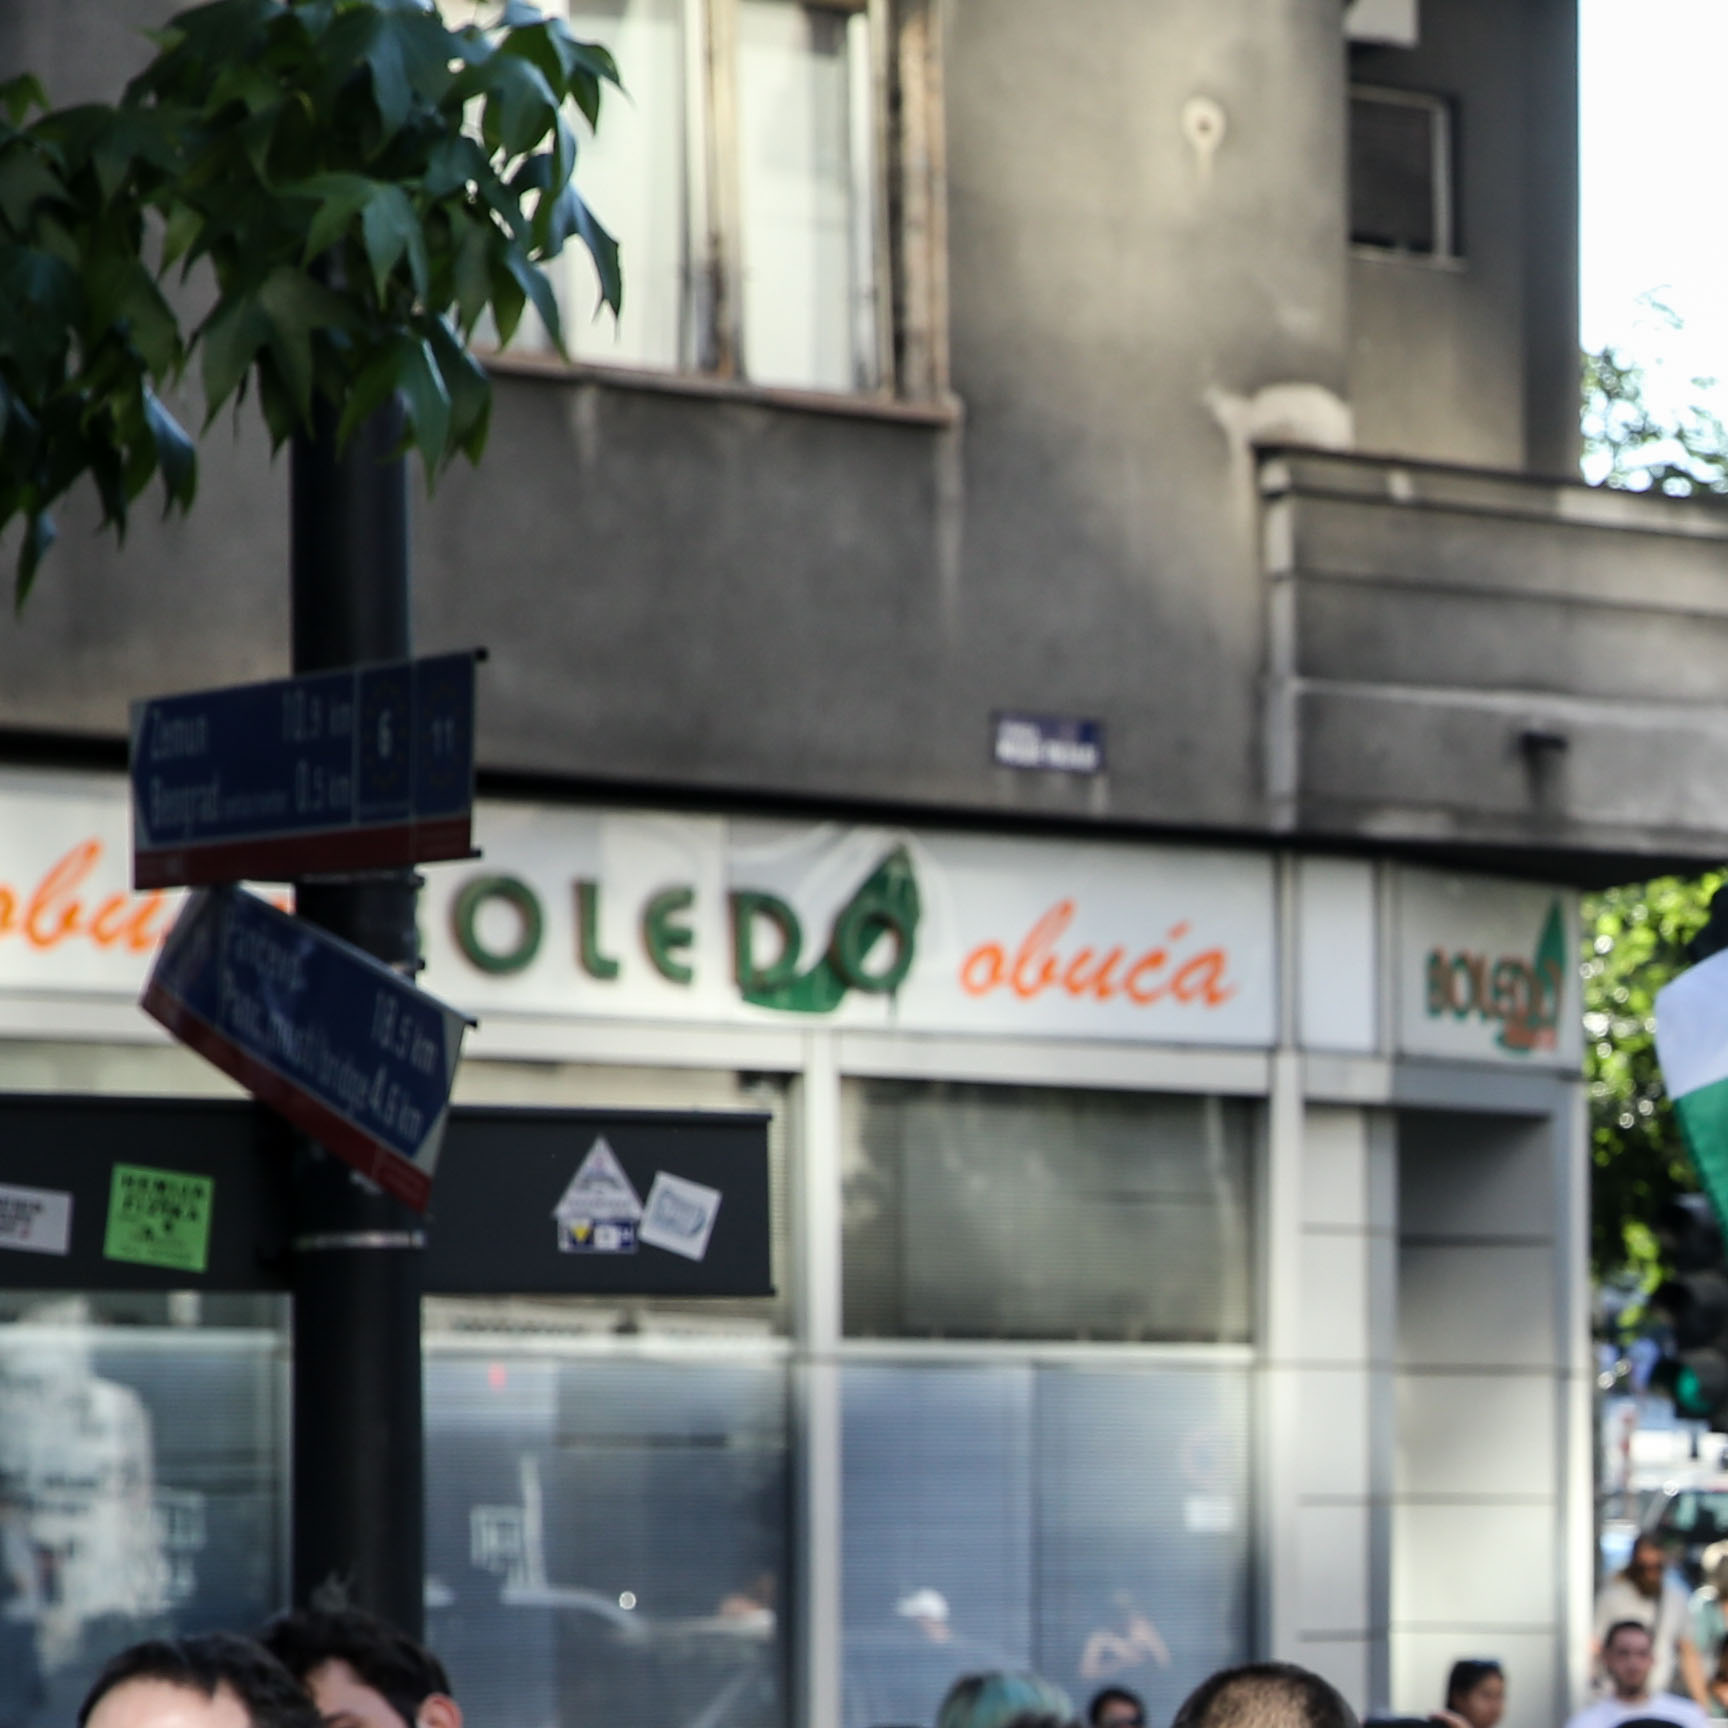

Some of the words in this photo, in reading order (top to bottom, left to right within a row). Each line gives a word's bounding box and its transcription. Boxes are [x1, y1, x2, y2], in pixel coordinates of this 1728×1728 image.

[377, 708, 393, 760] 6
[416, 874, 917, 995] OLEDO
[959, 898, 1239, 1010] obuća
